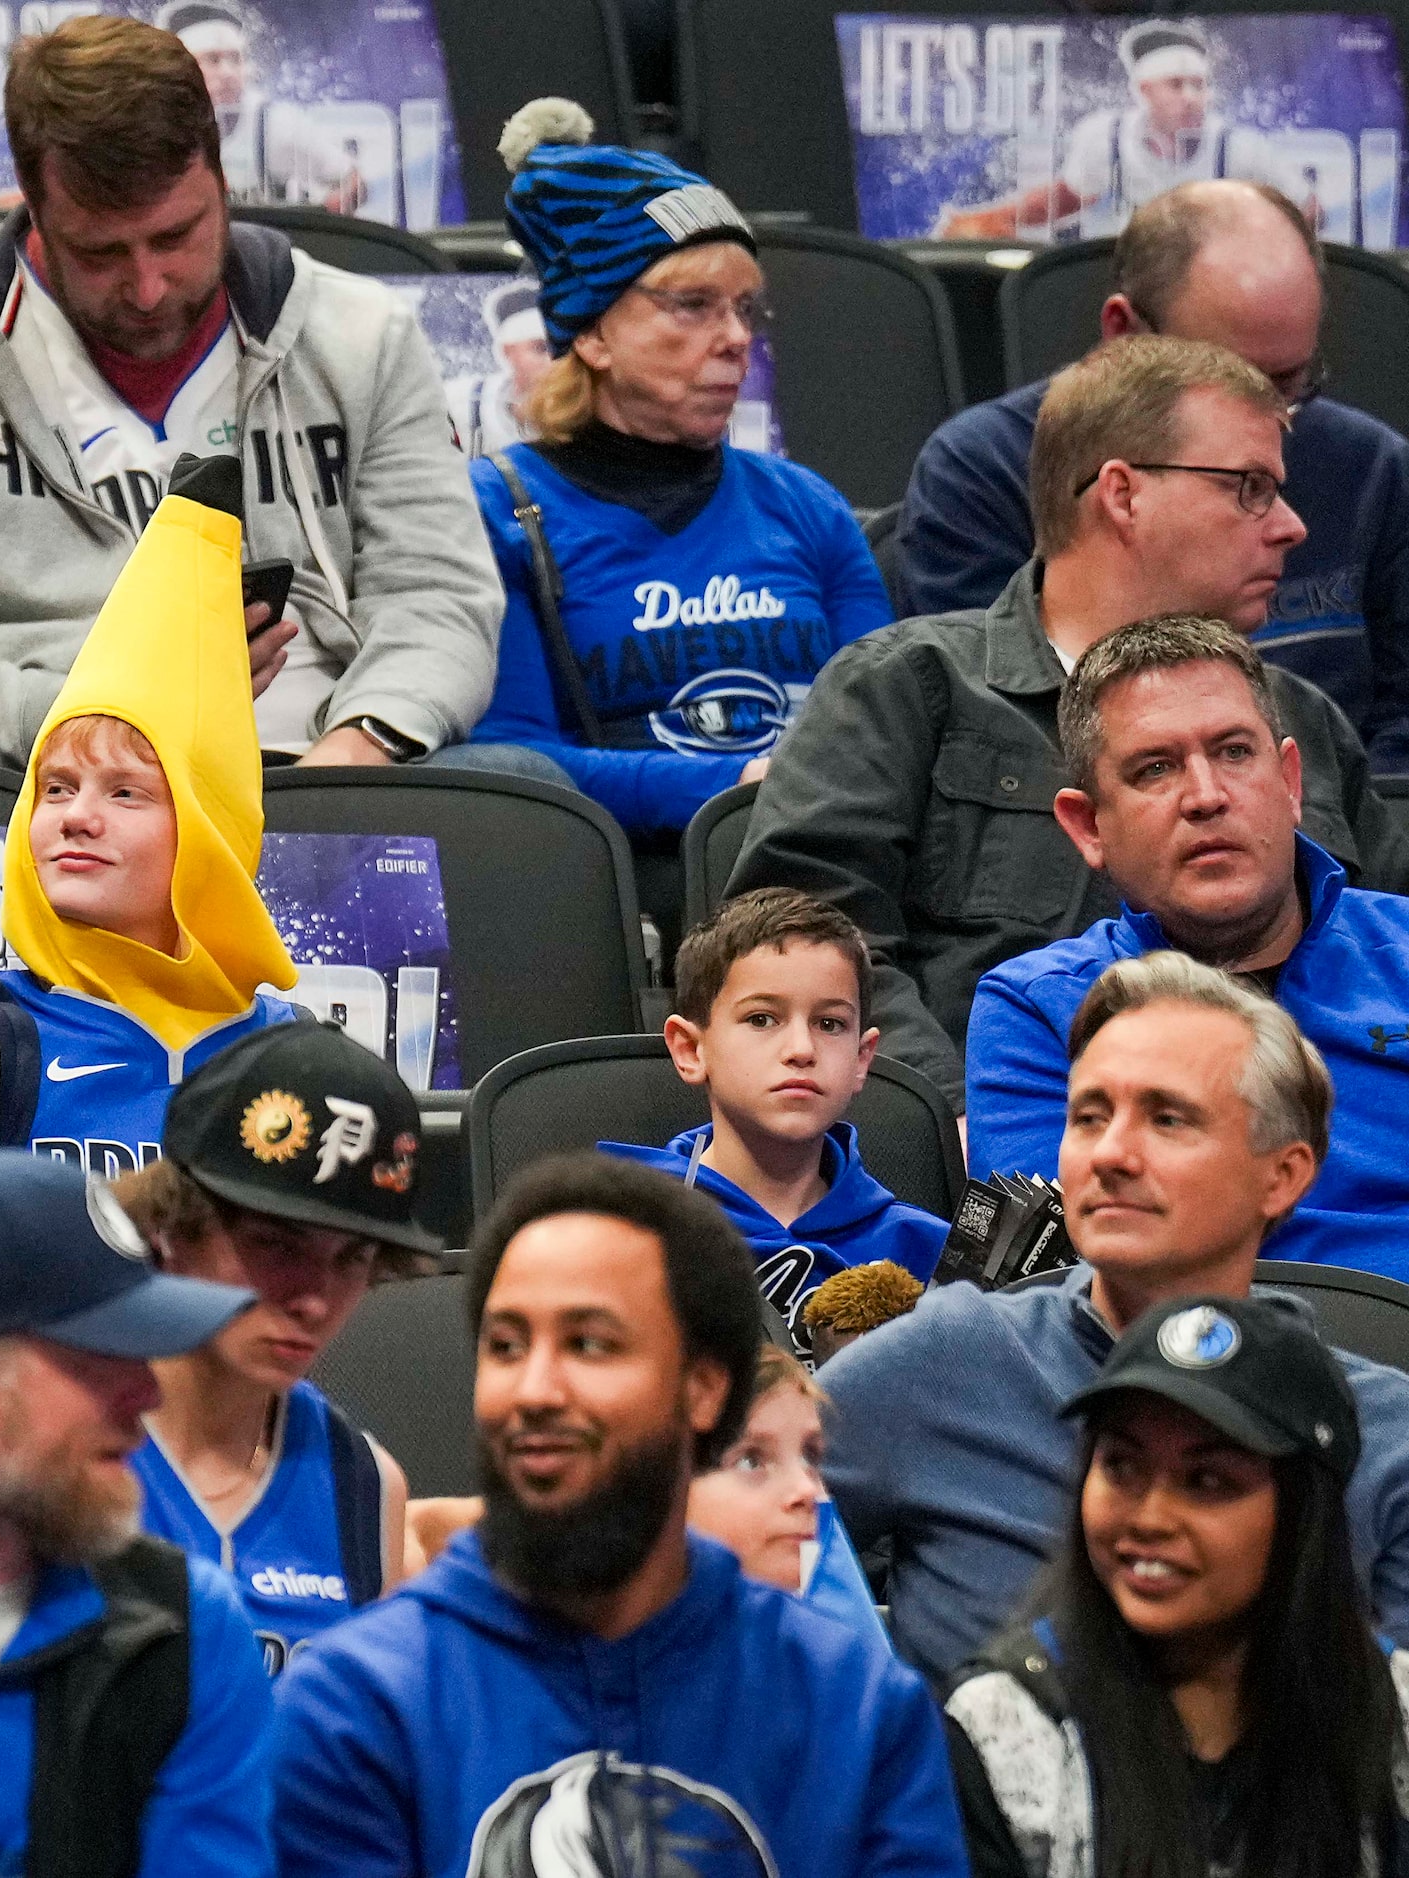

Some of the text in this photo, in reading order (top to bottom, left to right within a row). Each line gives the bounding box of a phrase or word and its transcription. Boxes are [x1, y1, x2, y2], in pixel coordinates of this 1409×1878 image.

[859, 23, 976, 136] LET'S
[633, 574, 786, 632] Dallas
[376, 858, 429, 874] EDIFIER
[251, 1566, 347, 1601] chime
